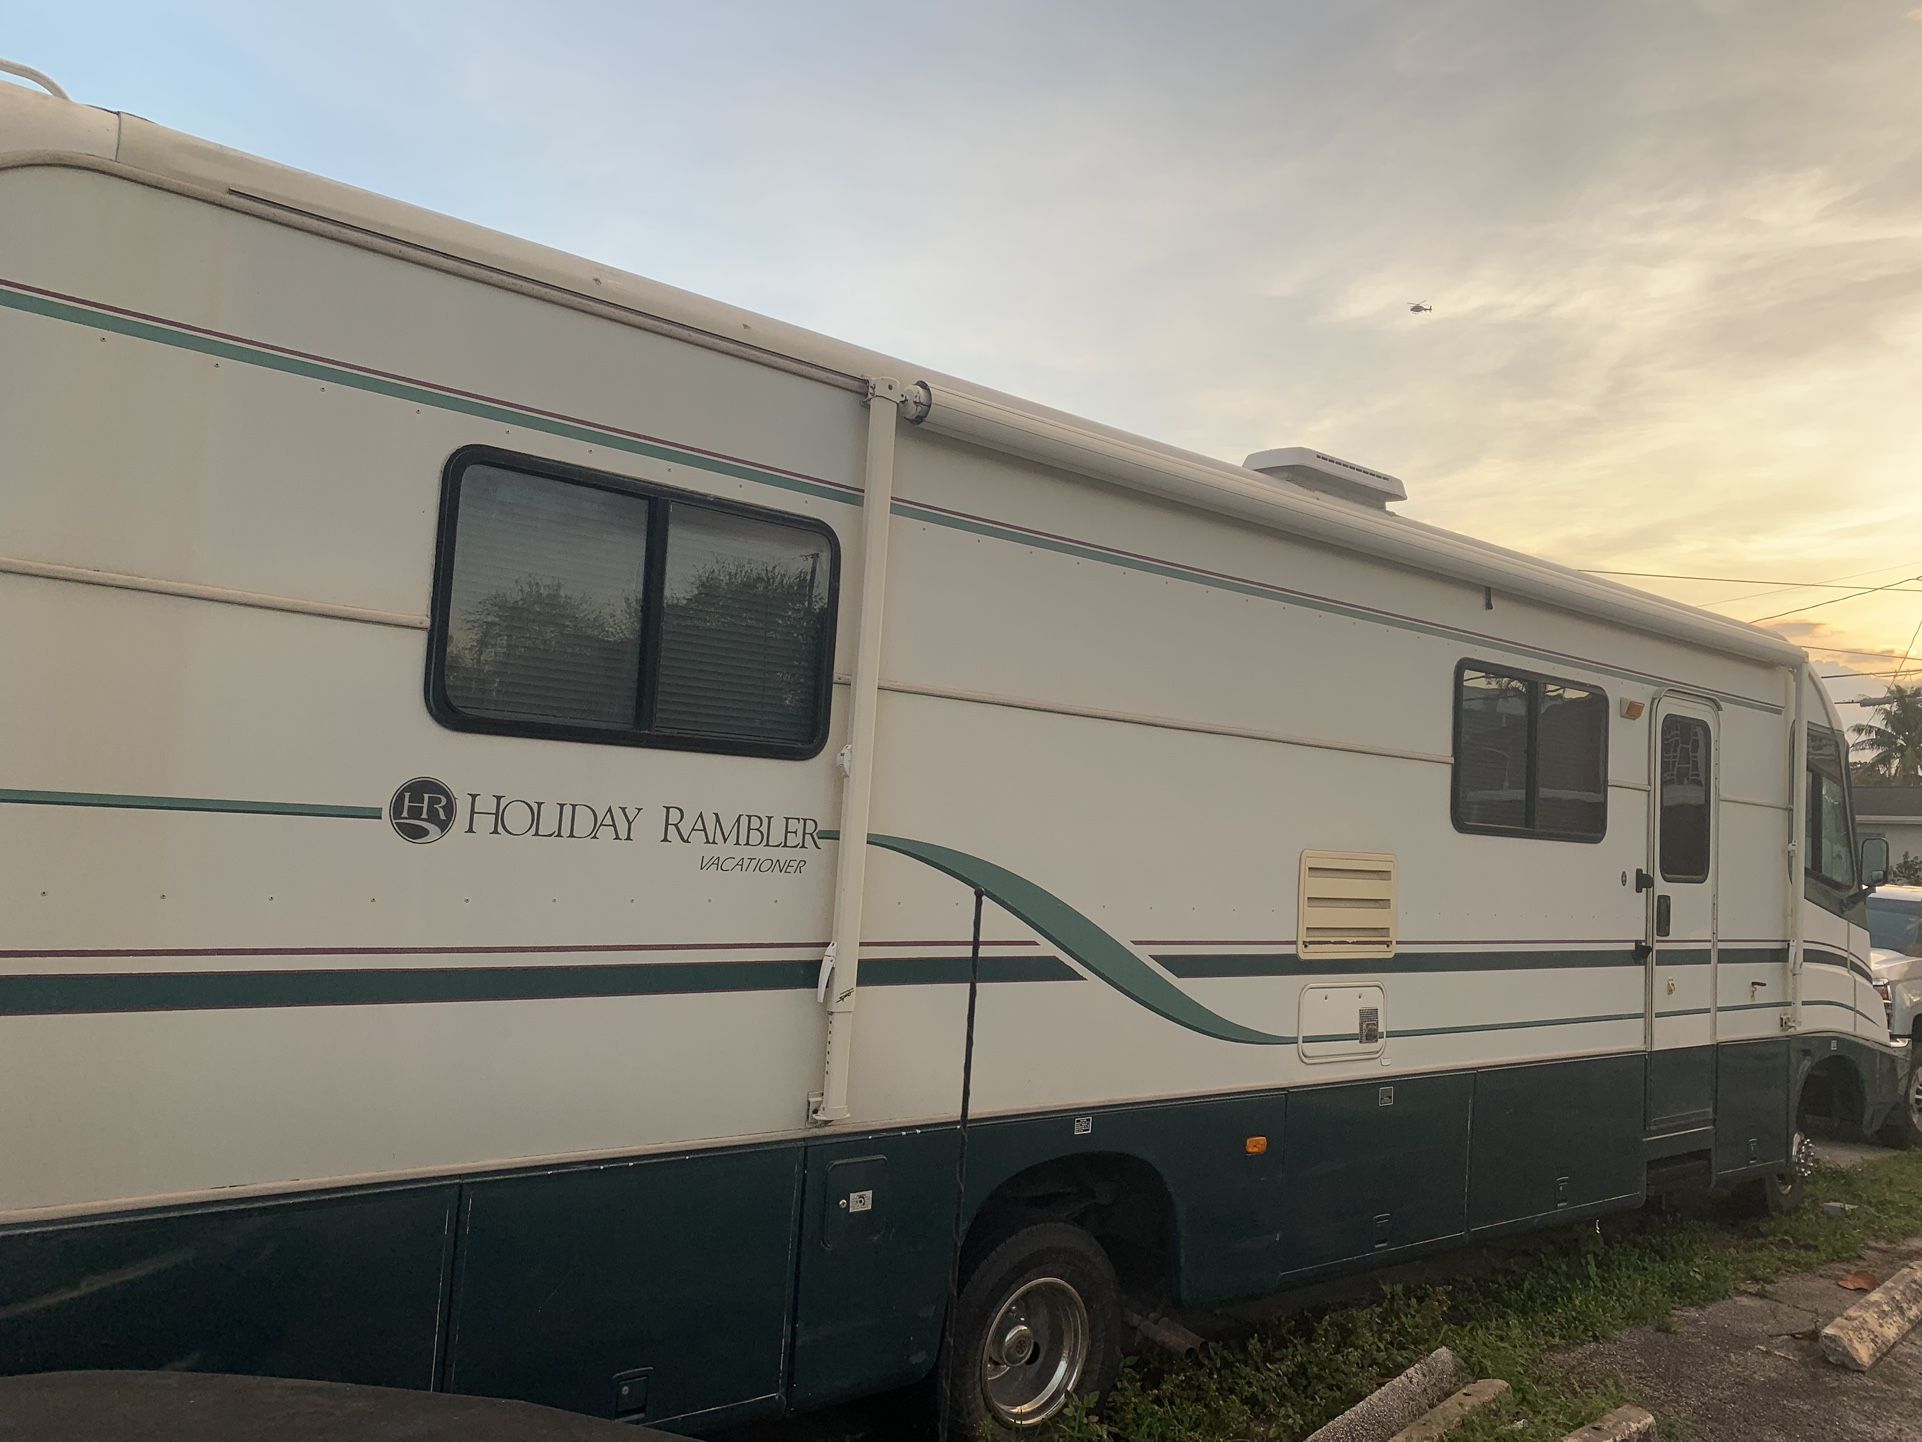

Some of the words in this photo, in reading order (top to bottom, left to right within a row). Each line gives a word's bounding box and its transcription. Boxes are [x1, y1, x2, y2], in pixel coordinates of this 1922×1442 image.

[402, 791, 449, 820] HR
[464, 793, 643, 842] HOLIDAY
[660, 805, 821, 850] RAMBLER
[699, 855, 807, 874] VACATIONER
